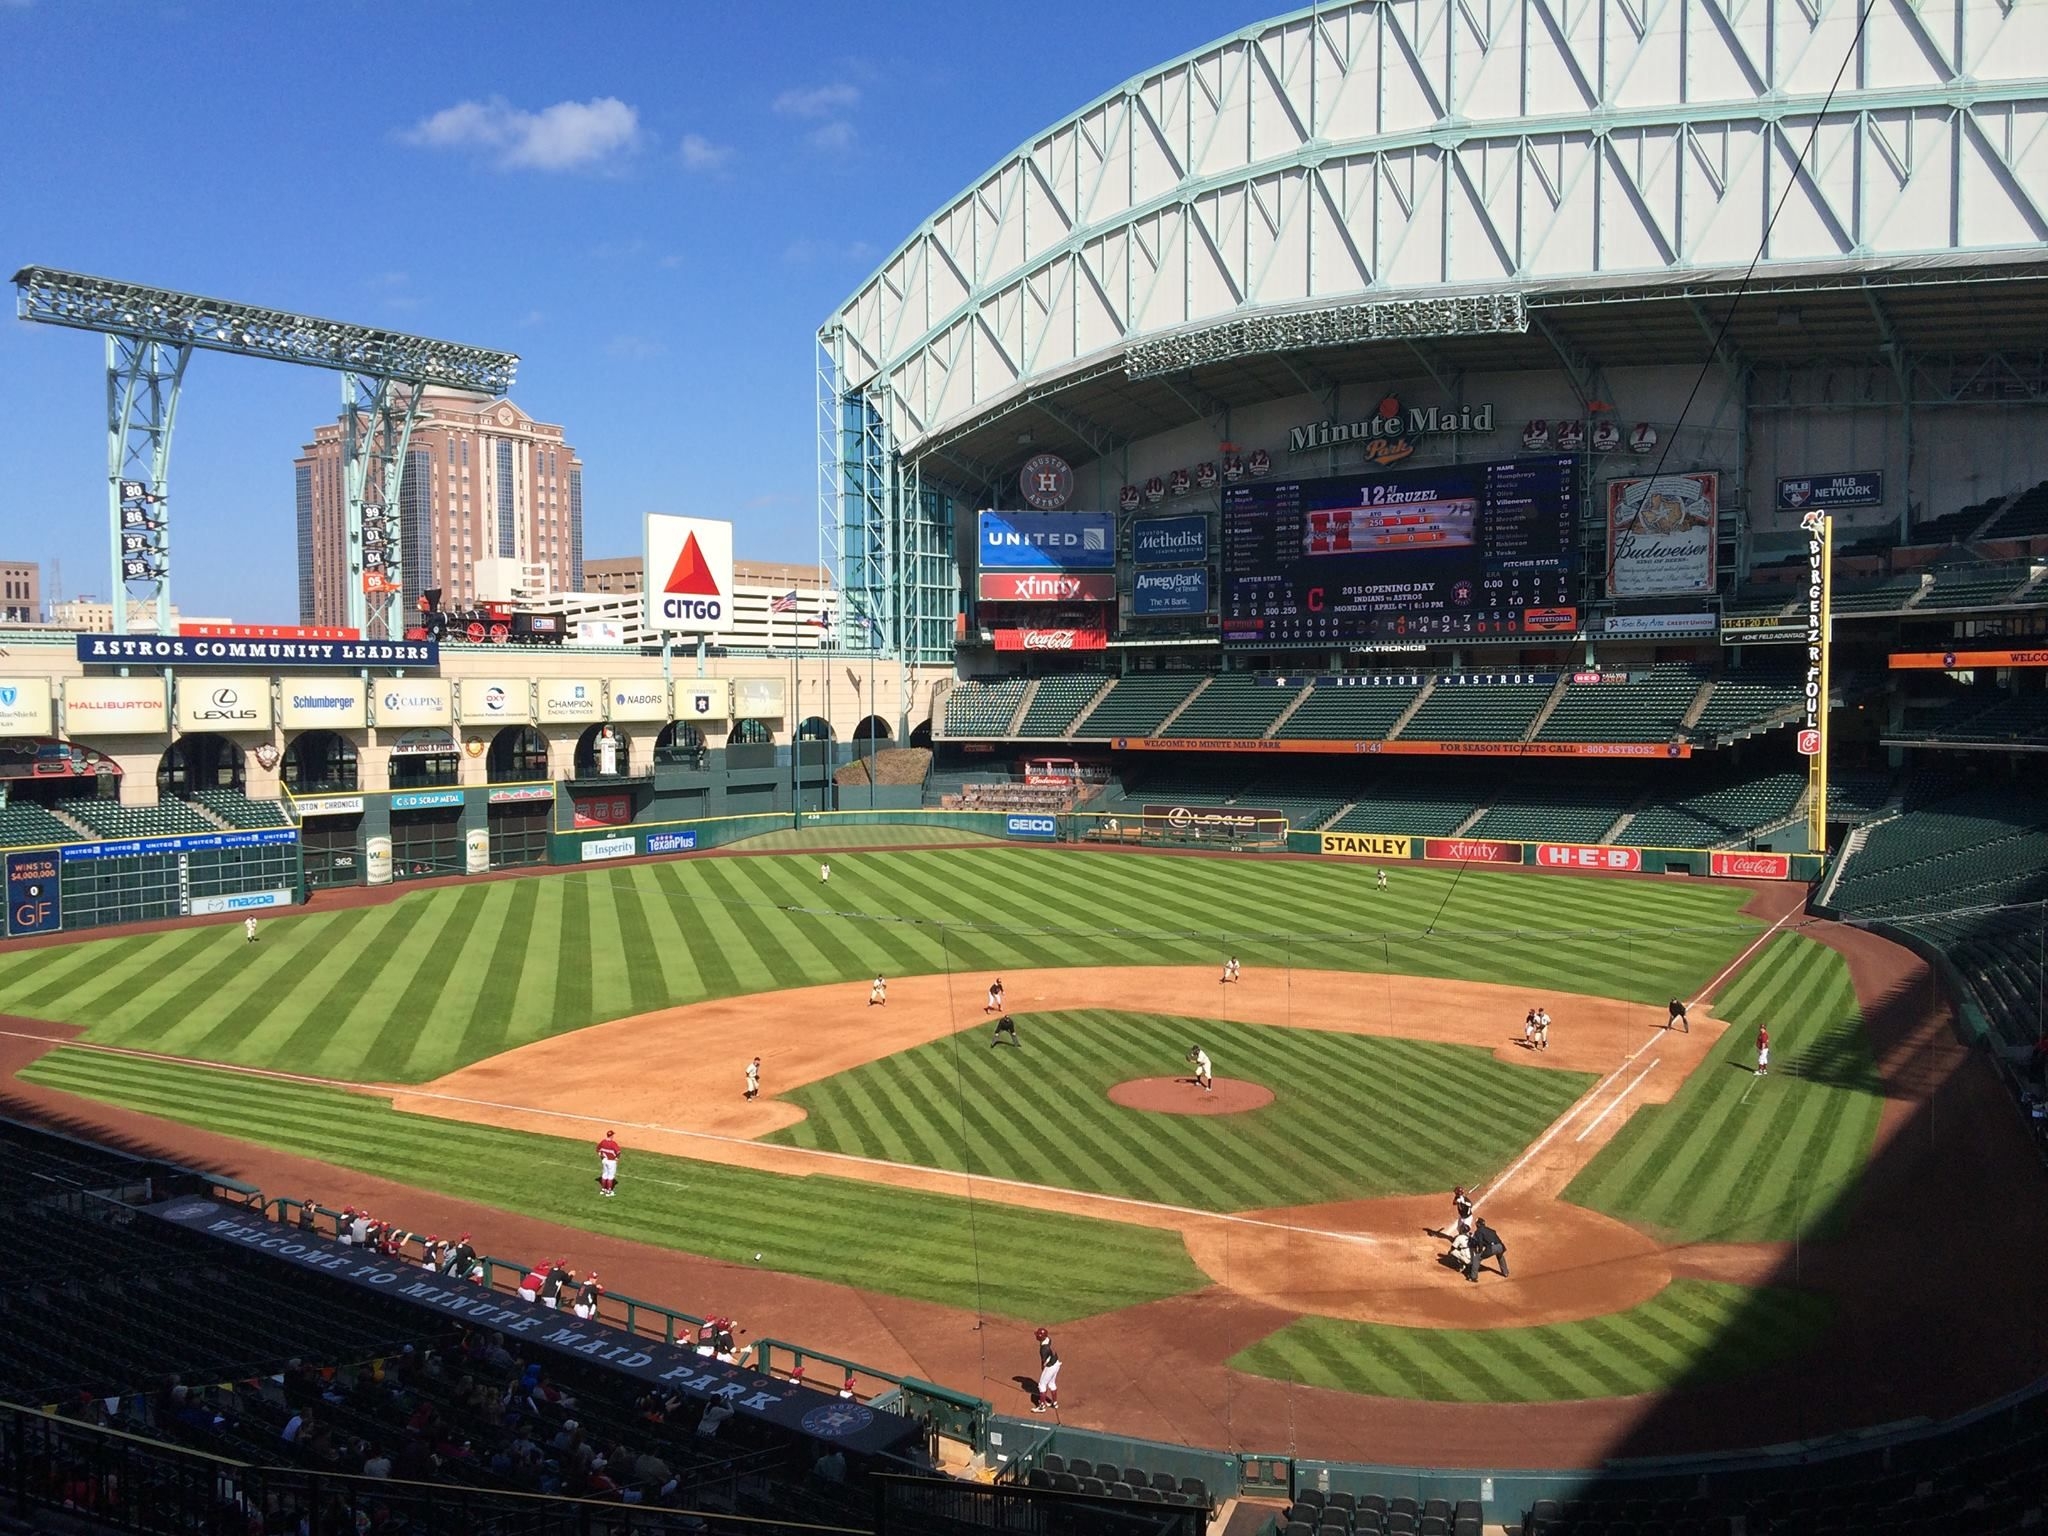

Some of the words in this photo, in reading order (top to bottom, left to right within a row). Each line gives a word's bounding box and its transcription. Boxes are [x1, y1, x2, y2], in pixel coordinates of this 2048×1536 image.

[1289, 415, 1401, 451] Minute
[1408, 403, 1494, 432] Maid
[1599, 421, 1611, 439] 5
[1637, 422, 1649, 441] 7
[1366, 438, 1409, 461] Park
[1026, 457, 1068, 472] HOUSTON
[1038, 473, 1057, 491] H
[1784, 482, 1809, 491] MLB
[1833, 477, 1856, 487] MLB
[126, 485, 142, 497] 80
[1360, 486, 1385, 506] 12
[1815, 486, 1872, 497] NETWORK
[1029, 494, 1065, 507] ASTROS
[1385, 490, 1438, 504] KRUZEL
[126, 511, 143, 522] 86
[366, 507, 379, 517] 99
[367, 531, 380, 540] 01
[988, 533, 1078, 546] UNITED
[1139, 531, 1203, 549] Methodist
[127, 537, 143, 548] 97
[1616, 536, 1708, 560] Budweiser
[367, 553, 381, 562] 04
[1536, 558, 1559, 566] STATS
[128, 563, 145, 574] 98
[368, 576, 382, 586] 05
[1014, 575, 1080, 598] xfinity
[1136, 573, 1202, 590] AmegyBank
[1484, 580, 1503, 588] 0.00
[1342, 586, 1362, 595] 2015
[1365, 583, 1411, 594] OPENING
[1413, 582, 1435, 592] DAY
[1807, 540, 1821, 643] BURGERZ
[1150, 598, 1163, 606] The
[1354, 595, 1385, 603] INDIANS
[1393, 593, 1423, 601] ASTROS
[1508, 597, 1523, 605] 1.0
[663, 599, 721, 620] CITGO
[1334, 604, 1367, 612] MONDAY
[1374, 602, 1397, 611] APRIL
[1419, 616, 1429, 624] 10
[1528, 615, 1573, 623] INVITATIONAL
[1763, 618, 1779, 626] AM
[199, 627, 279, 636] MINUTE
[297, 629, 345, 637] MAID
[1774, 632, 1806, 640] ADVANTAGE
[92, 641, 184, 656] ASTROS
[195, 643, 333, 658] COMMUNITY
[342, 645, 429, 659] LEADERS
[1809, 646, 1820, 661] R
[2010, 653, 2048, 662] WELCO
[1337, 677, 1418, 686] HOUSTON
[1459, 675, 1535, 684] ASTROS
[293, 695, 355, 711] Schlumberger
[401, 697, 443, 706] CALPINE
[627, 695, 662, 704] NABORS
[1806, 667, 1819, 728] FOUL
[68, 701, 163, 710] HALLIBURTON
[547, 699, 593, 709] CHAMPION
[193, 710, 257, 720] LEXUS
[1199, 740, 1231, 748] MINUTE
[1258, 741, 1280, 749] PARK
[1440, 743, 1461, 752] FOR
[1462, 744, 1500, 752] SEASON
[1502, 744, 1547, 753] TICKETS
[1550, 744, 1576, 753] CALL
[1578, 745, 1656, 755] 1-800-ASTROS2
[1029, 775, 1067, 785] Budweiser
[324, 800, 359, 809] CHRONICLE
[410, 796, 417, 805] D
[419, 796, 439, 804] SCRAP
[440, 795, 459, 803] METAL
[1008, 818, 1055, 832] GEICO
[594, 841, 634, 856] Insperity
[649, 836, 695, 851] TexanPlus
[1324, 837, 1407, 854] STANLEY
[1449, 842, 1498, 860] xfinity
[334, 857, 352, 866] 362
[1549, 847, 1630, 867] H-E-B
[15, 863, 38, 871] WINS
[1732, 856, 1777, 874] Coca-Cola
[180, 855, 188, 913] AMERICAN
[29, 886, 39, 896] 0
[228, 894, 275, 908] mazda
[206, 1219, 353, 1270] WELCOME
[348, 1265, 398, 1285] TO
[398, 1282, 544, 1332] MINUTE
[542, 1327, 654, 1369] MAID
[659, 1365, 782, 1412] PARK
